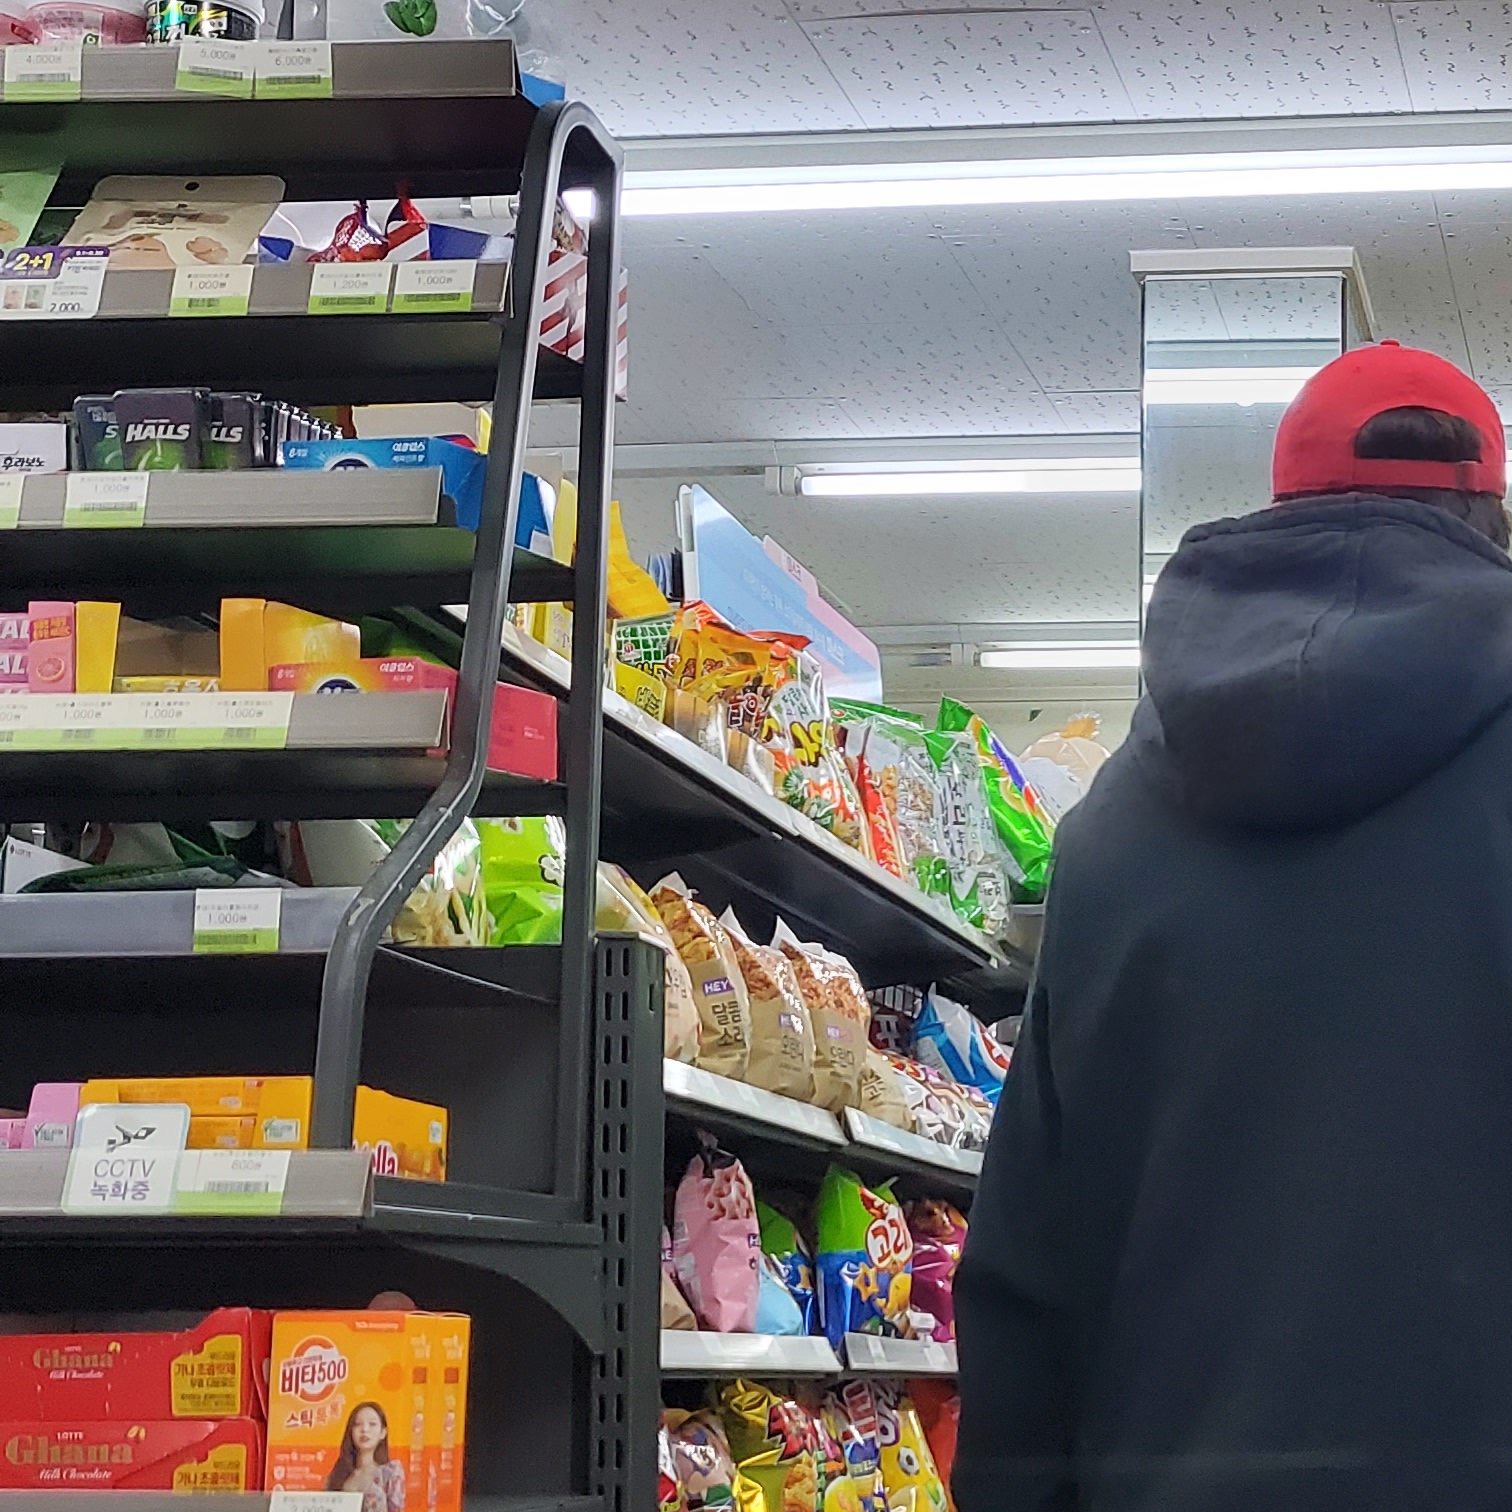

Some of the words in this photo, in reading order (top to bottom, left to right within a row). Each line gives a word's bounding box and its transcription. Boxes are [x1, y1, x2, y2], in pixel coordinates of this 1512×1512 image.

[14, 252, 54, 271] 2+1
[124, 422, 192, 443] HALLS
[703, 978, 731, 995] HEY
[711, 1001, 743, 1026] 달콤
[93, 1158, 156, 1179] CCTV
[89, 1180, 151, 1202] 녹화중
[33, 1347, 115, 1369] Ghana
[281, 1359, 347, 1394] 비타500
[57, 1431, 85, 1440] LOTTE
[5, 1434, 134, 1465] Ghana
